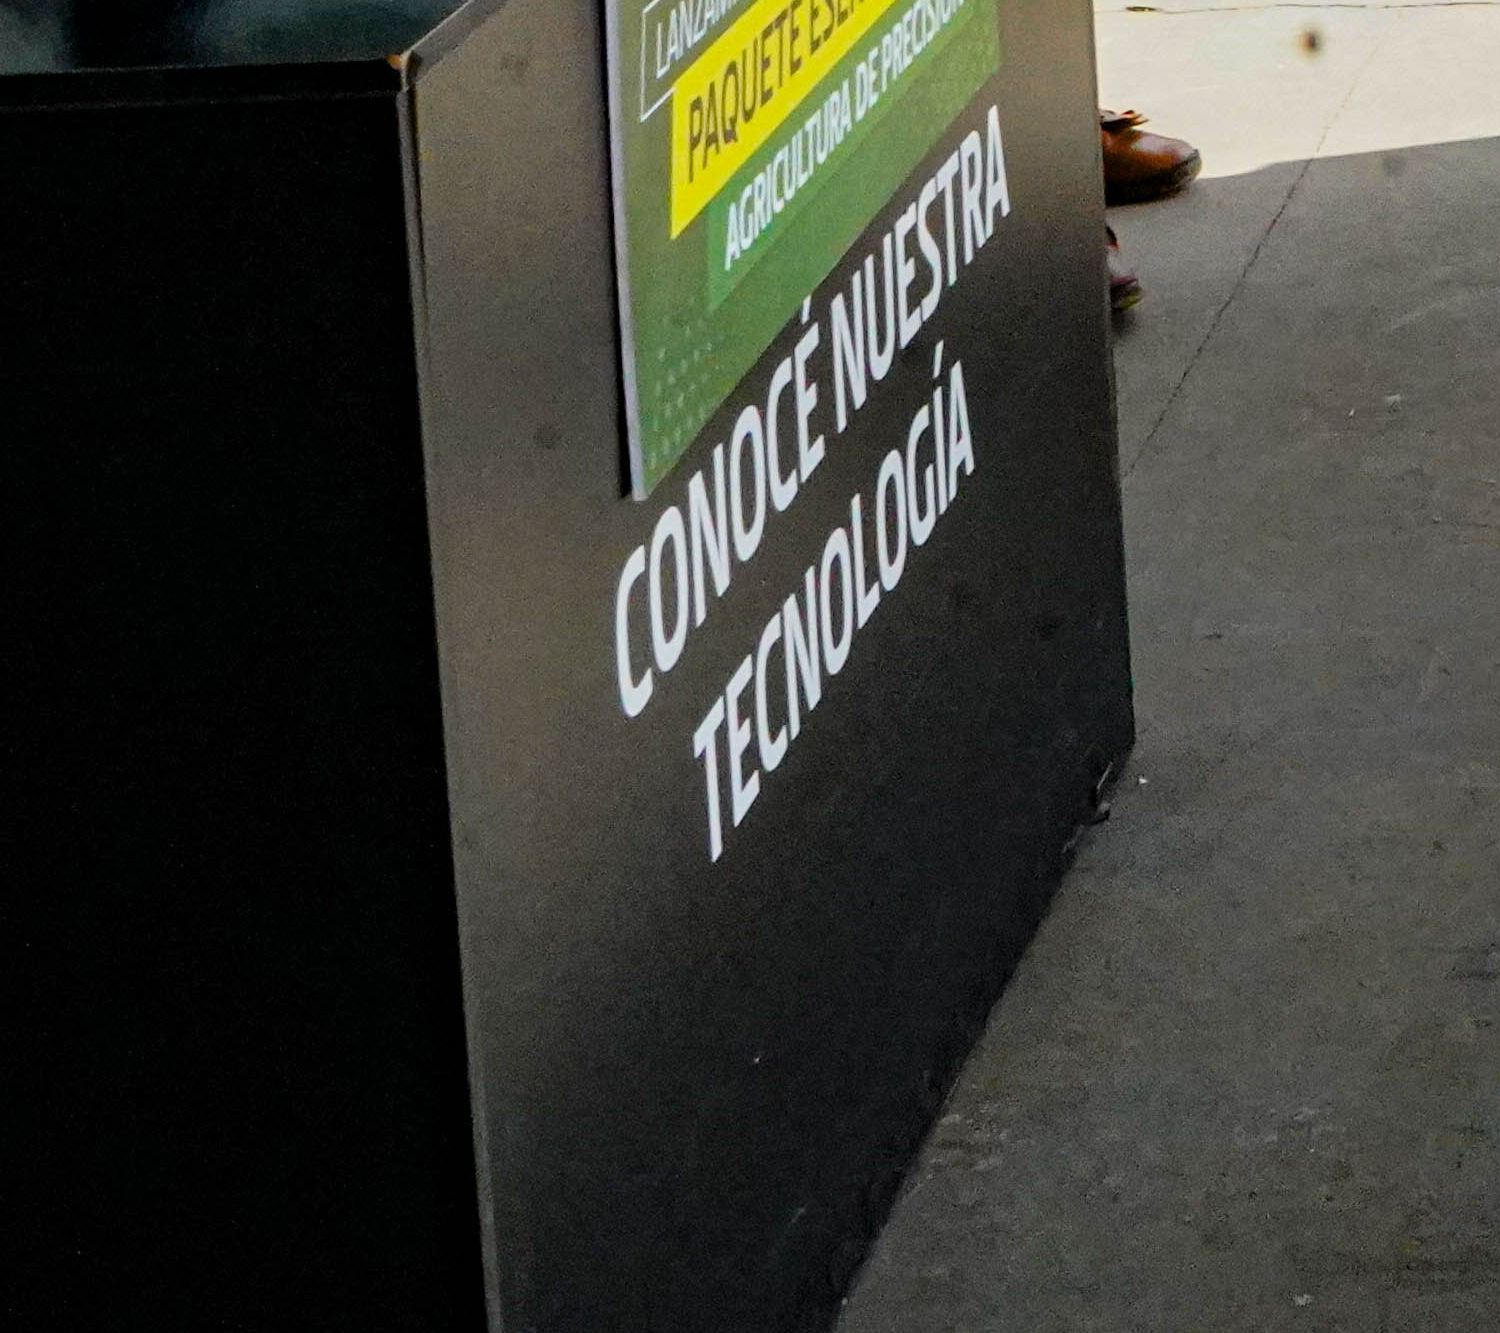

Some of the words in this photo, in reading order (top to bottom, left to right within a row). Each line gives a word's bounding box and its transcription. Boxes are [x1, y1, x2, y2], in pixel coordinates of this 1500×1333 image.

[615, 294, 826, 719] CONOCÉ
[832, 104, 1011, 435] NUESTRA
[724, 80, 853, 271] AGRICULTURA
[855, 62, 880, 119] DE
[693, 339, 975, 863] TECNOLOGÍA
